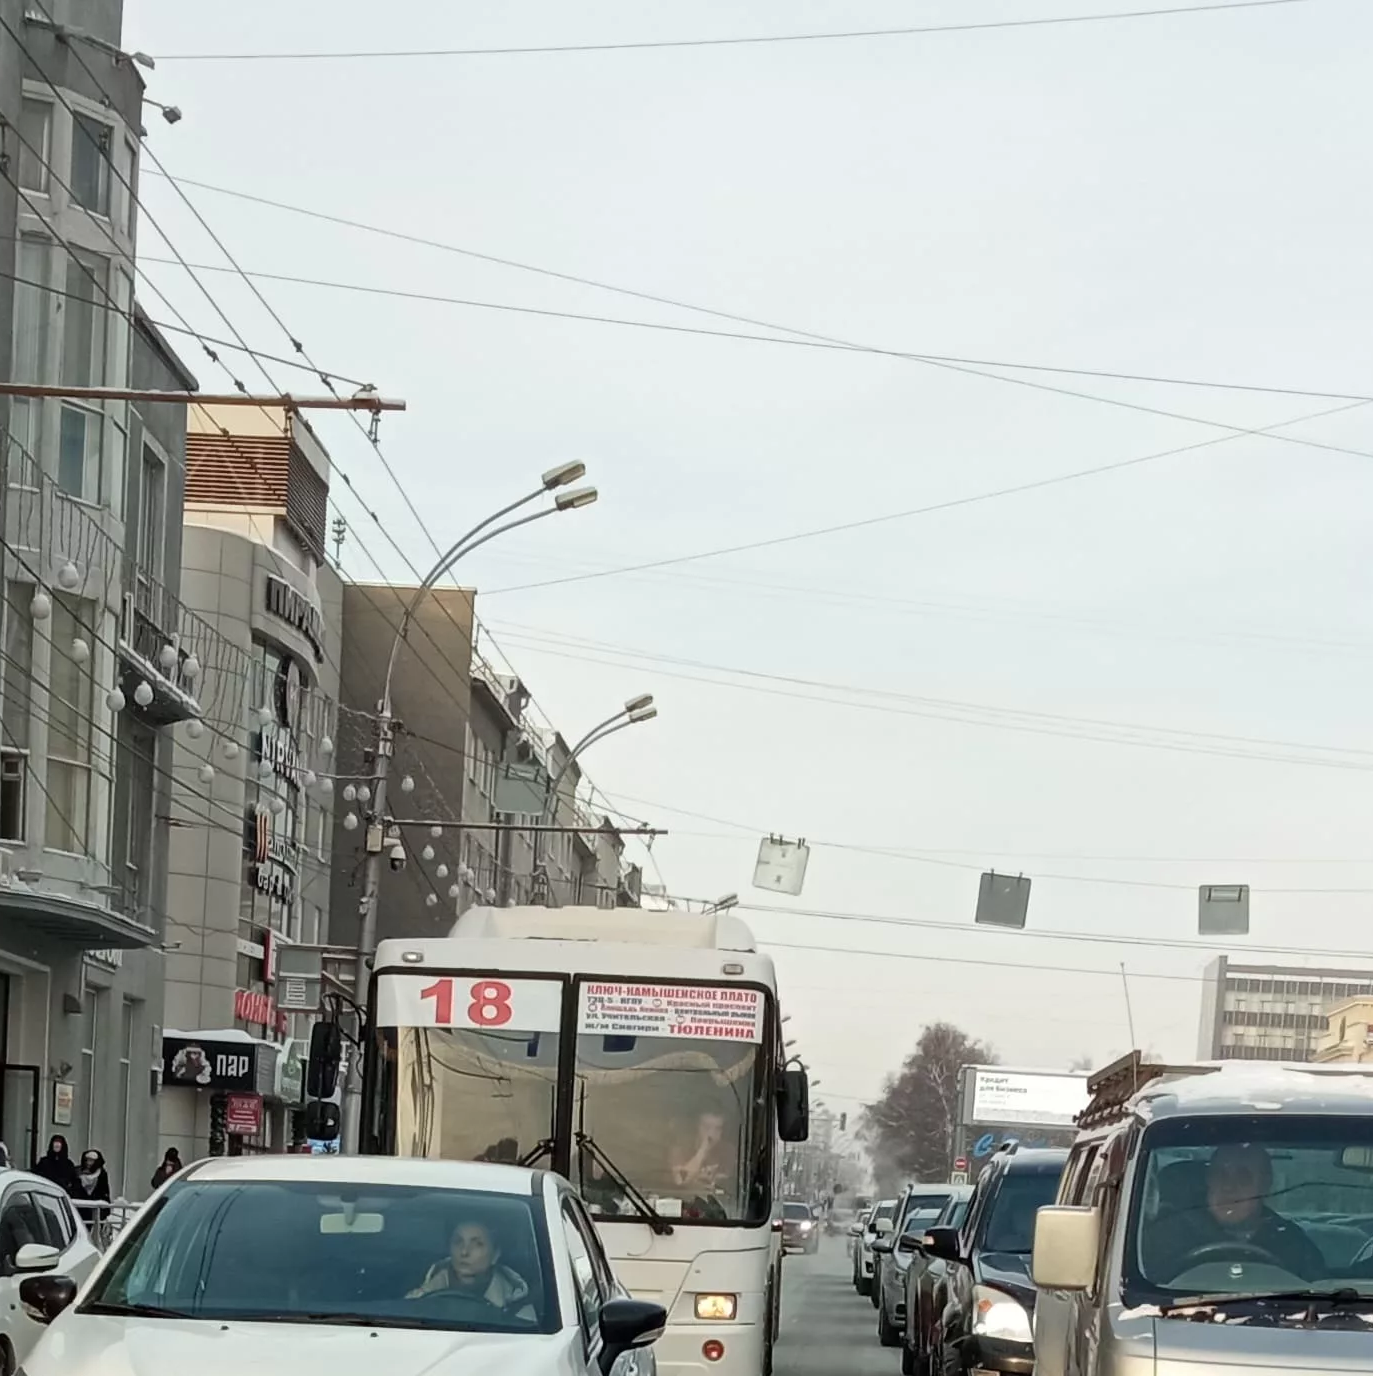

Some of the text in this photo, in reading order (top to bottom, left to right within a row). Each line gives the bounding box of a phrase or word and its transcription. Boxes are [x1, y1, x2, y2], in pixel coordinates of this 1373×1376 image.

[420, 979, 512, 1026] 18
[721, 991, 757, 1003] ПЛАТО
[668, 1024, 754, 1039] ТЮЛЕНИНА
